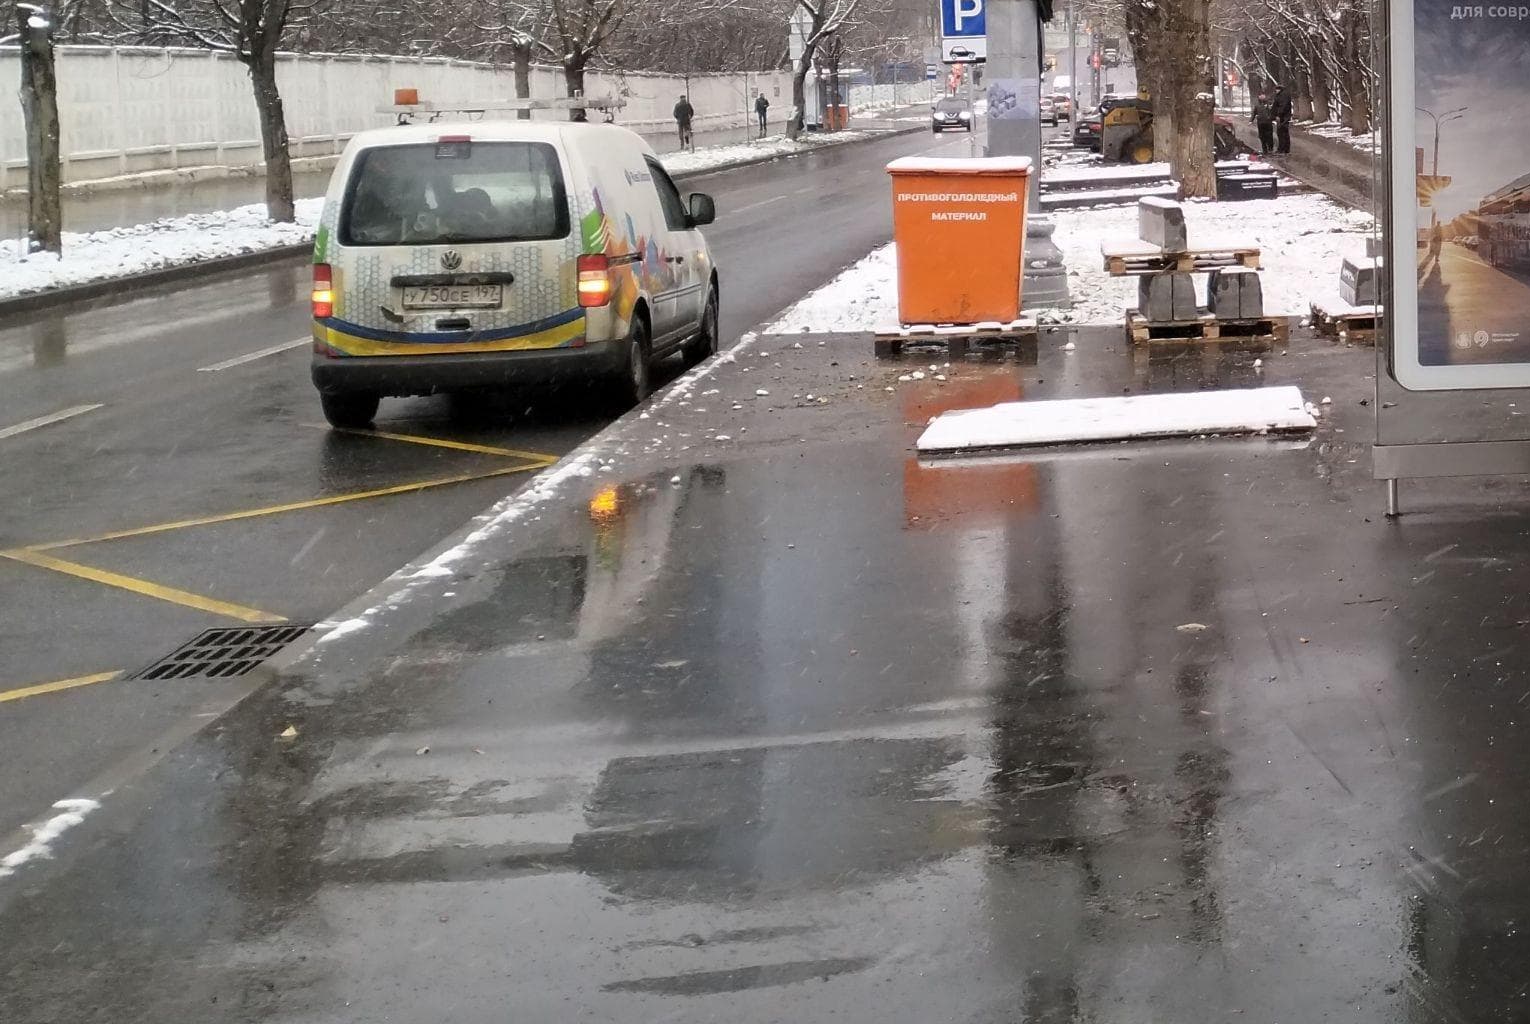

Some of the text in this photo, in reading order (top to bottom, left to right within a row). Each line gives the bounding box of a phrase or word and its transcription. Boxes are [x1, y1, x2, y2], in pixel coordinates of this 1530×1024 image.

[1451, 5, 1483, 19] для
[898, 192, 1018, 202] ПРОТИВОГОЛОЛЕДНЫЙ
[931, 212, 987, 221] МАТЕРИАЛ
